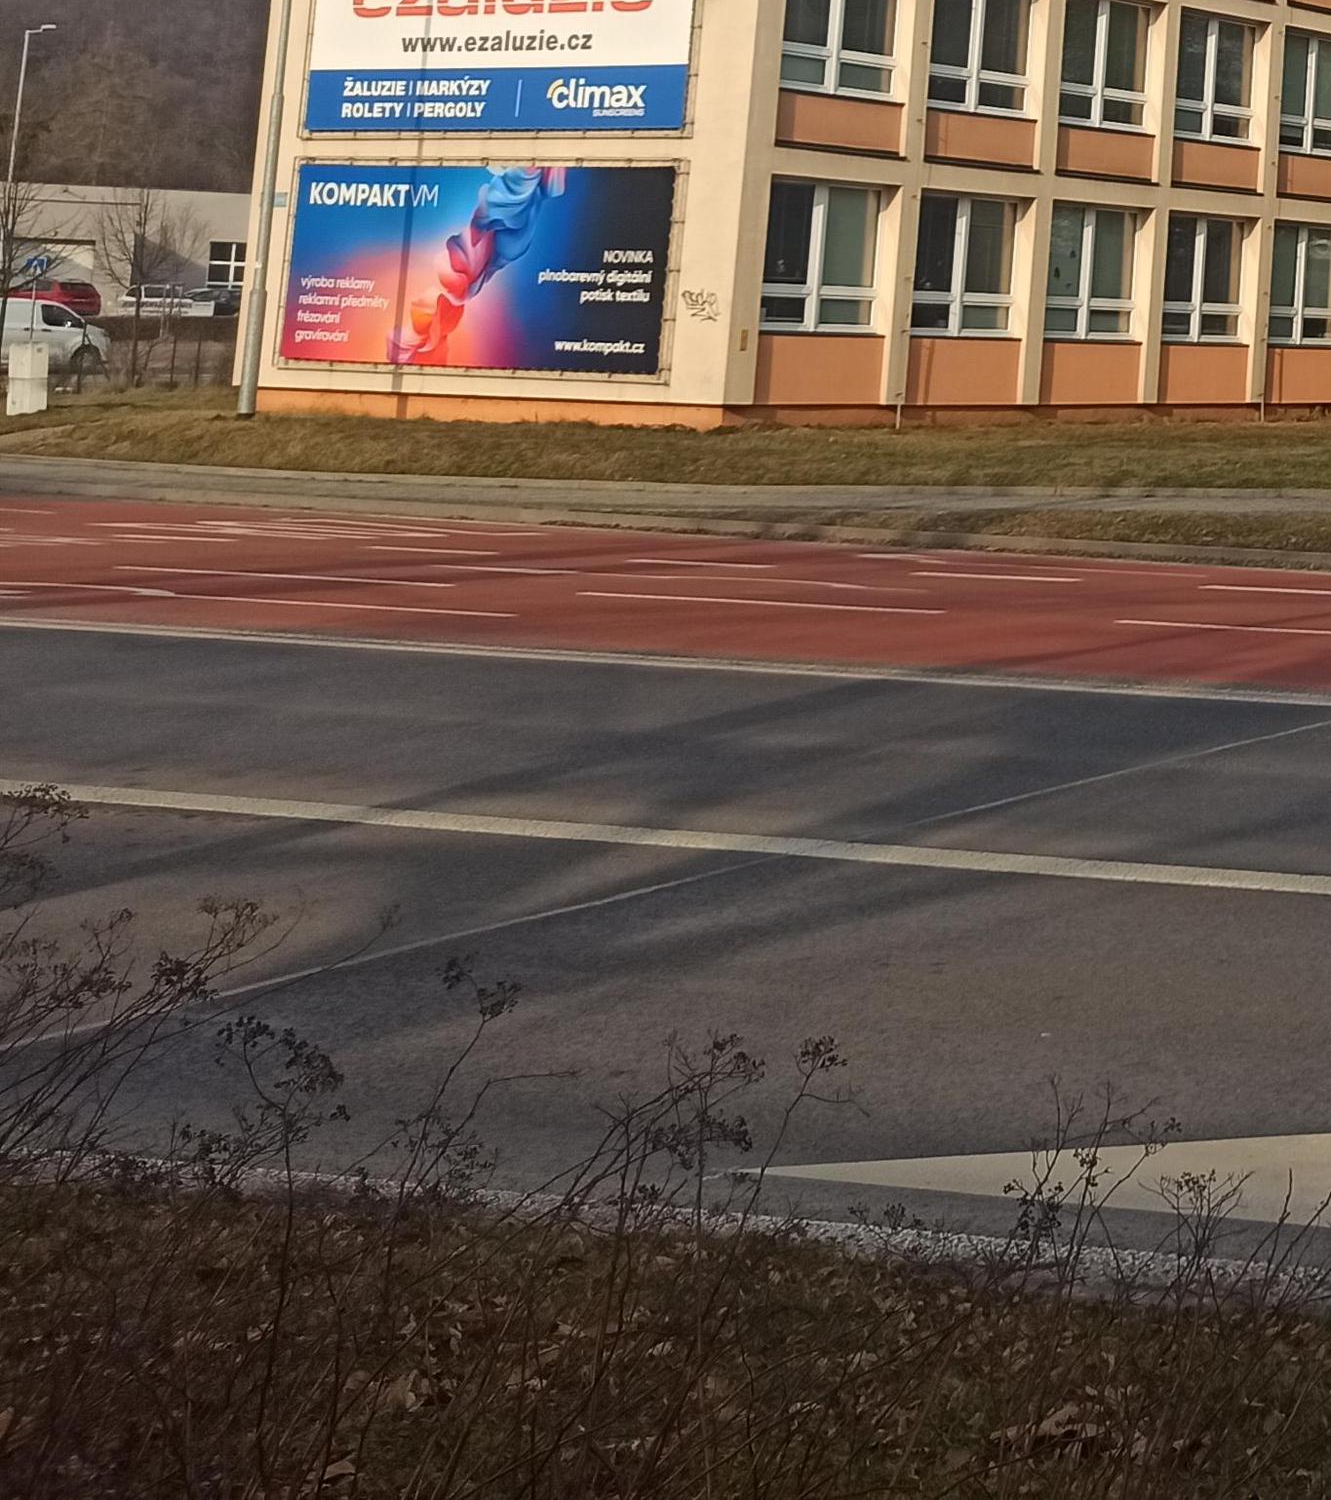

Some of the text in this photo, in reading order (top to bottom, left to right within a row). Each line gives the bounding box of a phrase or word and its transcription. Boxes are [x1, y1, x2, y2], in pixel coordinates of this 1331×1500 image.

[401, 29, 593, 52] www.ezaluzie.cz
[342, 75, 491, 97] ŽALUZIE MARKÝZY
[549, 78, 648, 109] climax
[341, 101, 486, 118] ROLETY PERGOLY
[603, 250, 653, 264] NOVINKA
[301, 275, 335, 290] výroba
[554, 339, 646, 356] www.kompakt.cz
